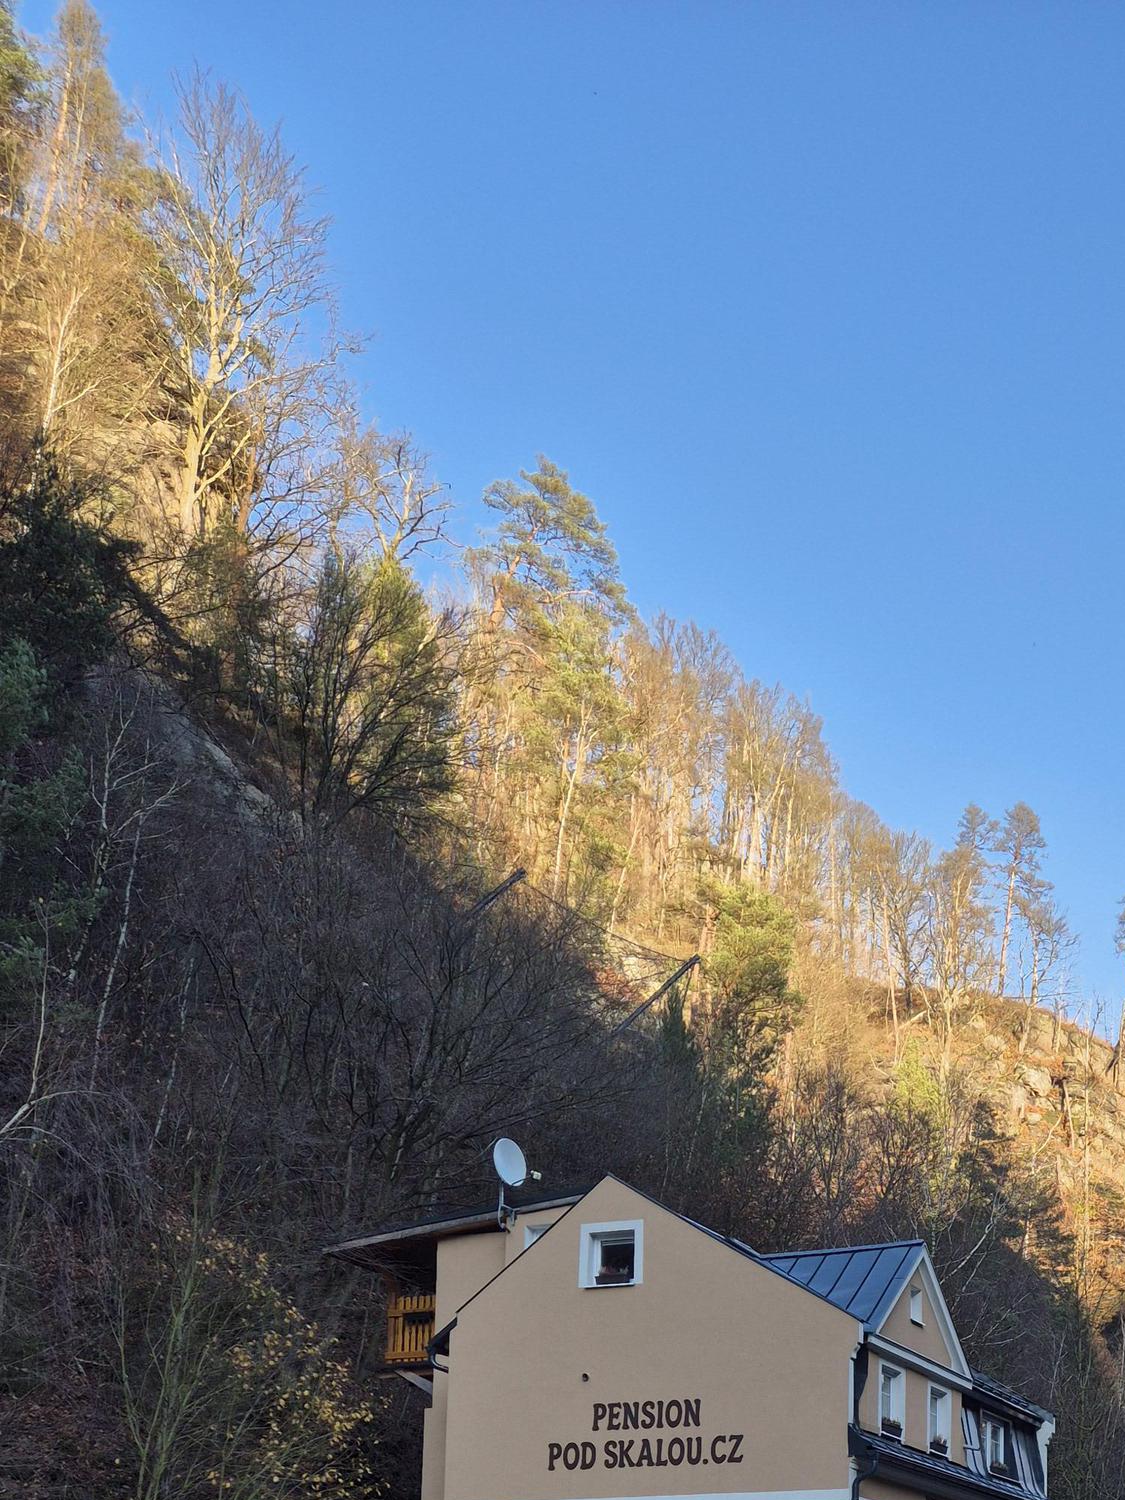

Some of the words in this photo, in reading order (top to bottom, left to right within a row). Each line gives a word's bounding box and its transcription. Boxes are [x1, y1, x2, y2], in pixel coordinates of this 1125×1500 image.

[592, 1398, 701, 1431] PENSION
[548, 1441, 597, 1471] POD
[603, 1434, 744, 1469] SKALOU.CZ
